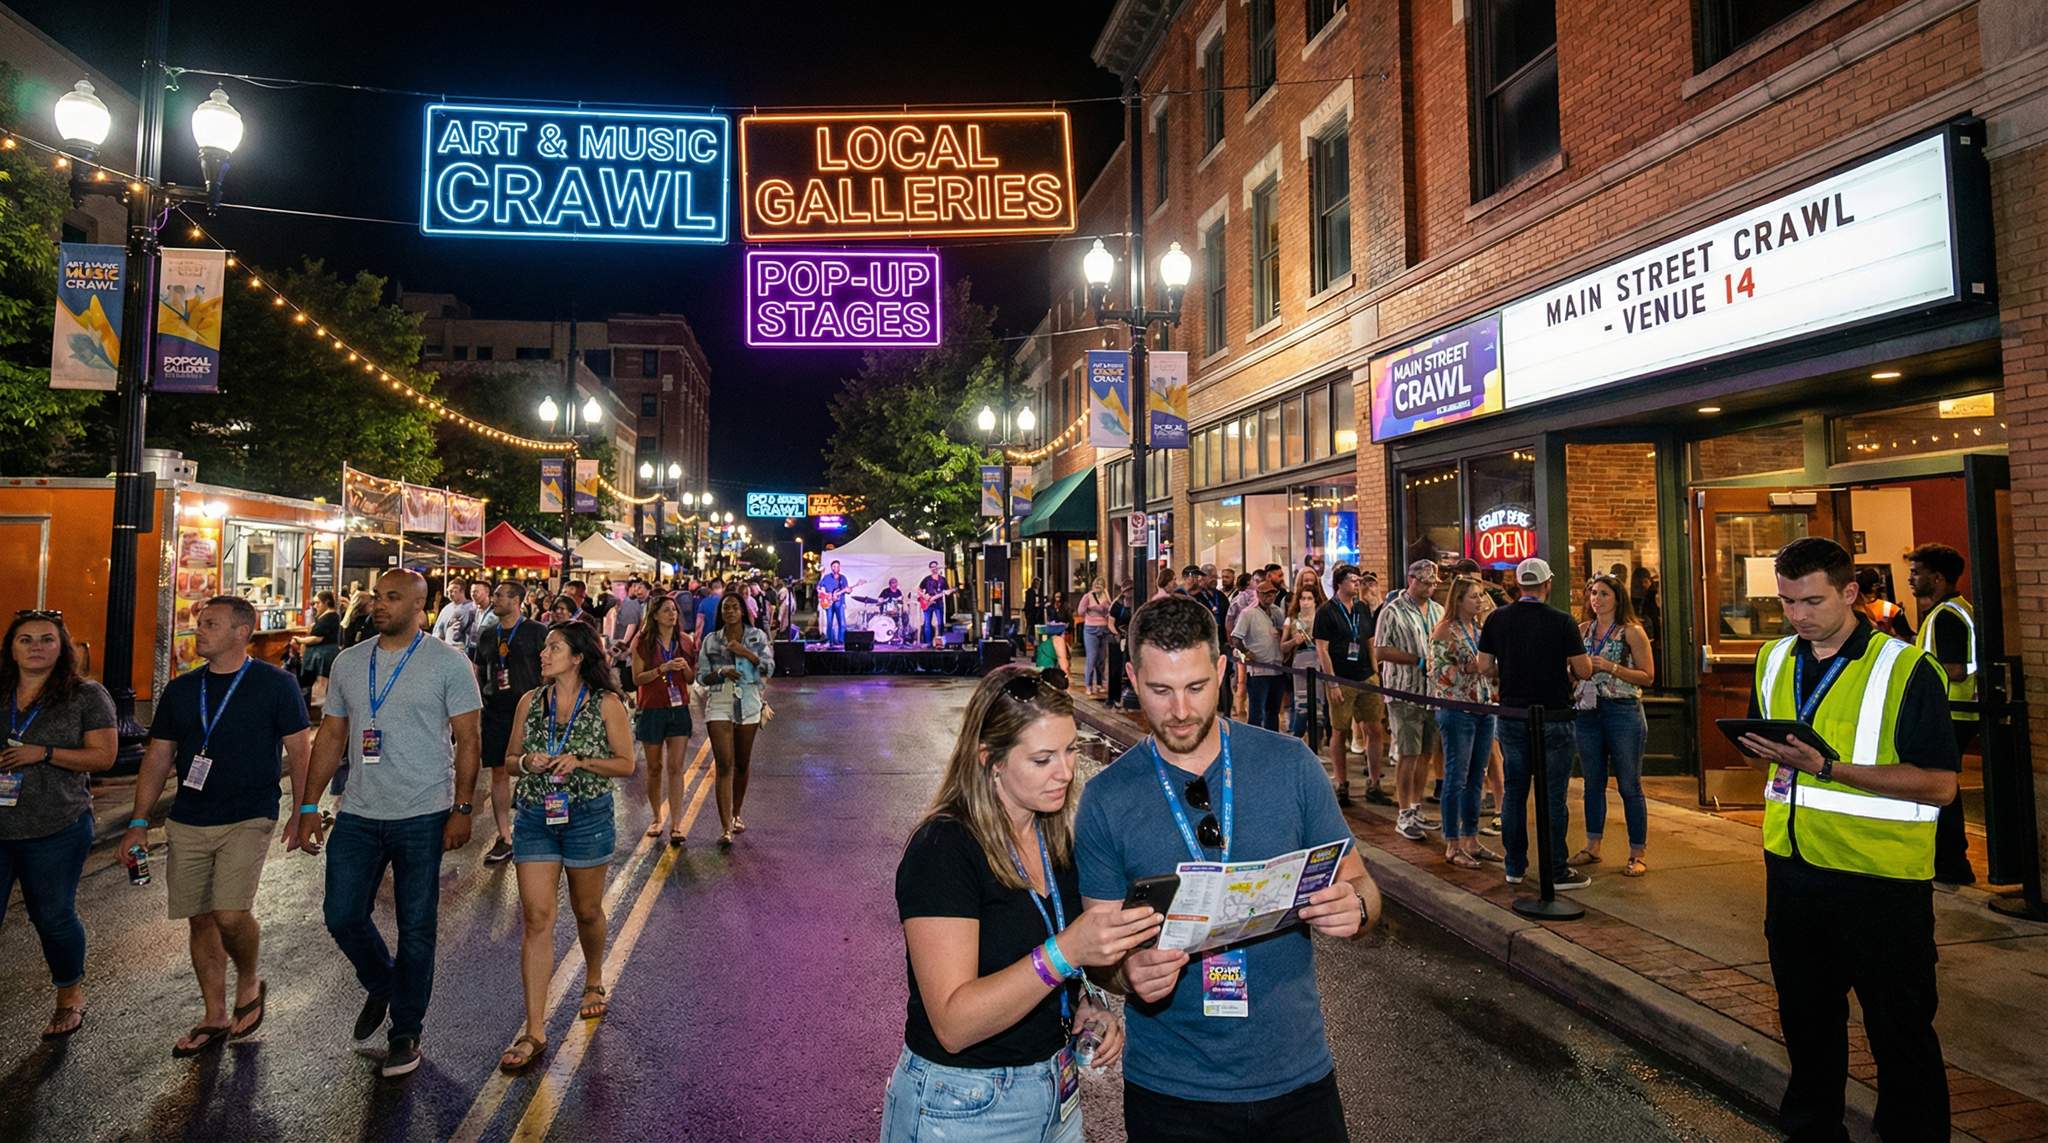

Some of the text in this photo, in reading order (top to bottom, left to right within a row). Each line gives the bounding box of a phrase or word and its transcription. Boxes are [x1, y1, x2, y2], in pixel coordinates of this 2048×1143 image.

[437, 119, 718, 163] ART & MUSIC
[816, 124, 999, 172] LOCAL
[436, 161, 717, 230] CRAWL
[755, 173, 1063, 226] GALLERIES
[757, 260, 931, 298] POP-UP
[1546, 192, 1855, 328] MAIN STREET CRAWL
[66, 279, 118, 290] CRAWL
[1623, 282, 1706, 334] VENUE
[1724, 266, 1755, 304] 14
[757, 301, 931, 338] STAGES
[1394, 341, 1470, 383] MAIN STREET
[1395, 364, 1472, 412] CRAWL
[1480, 530, 1528, 559] OPEN
